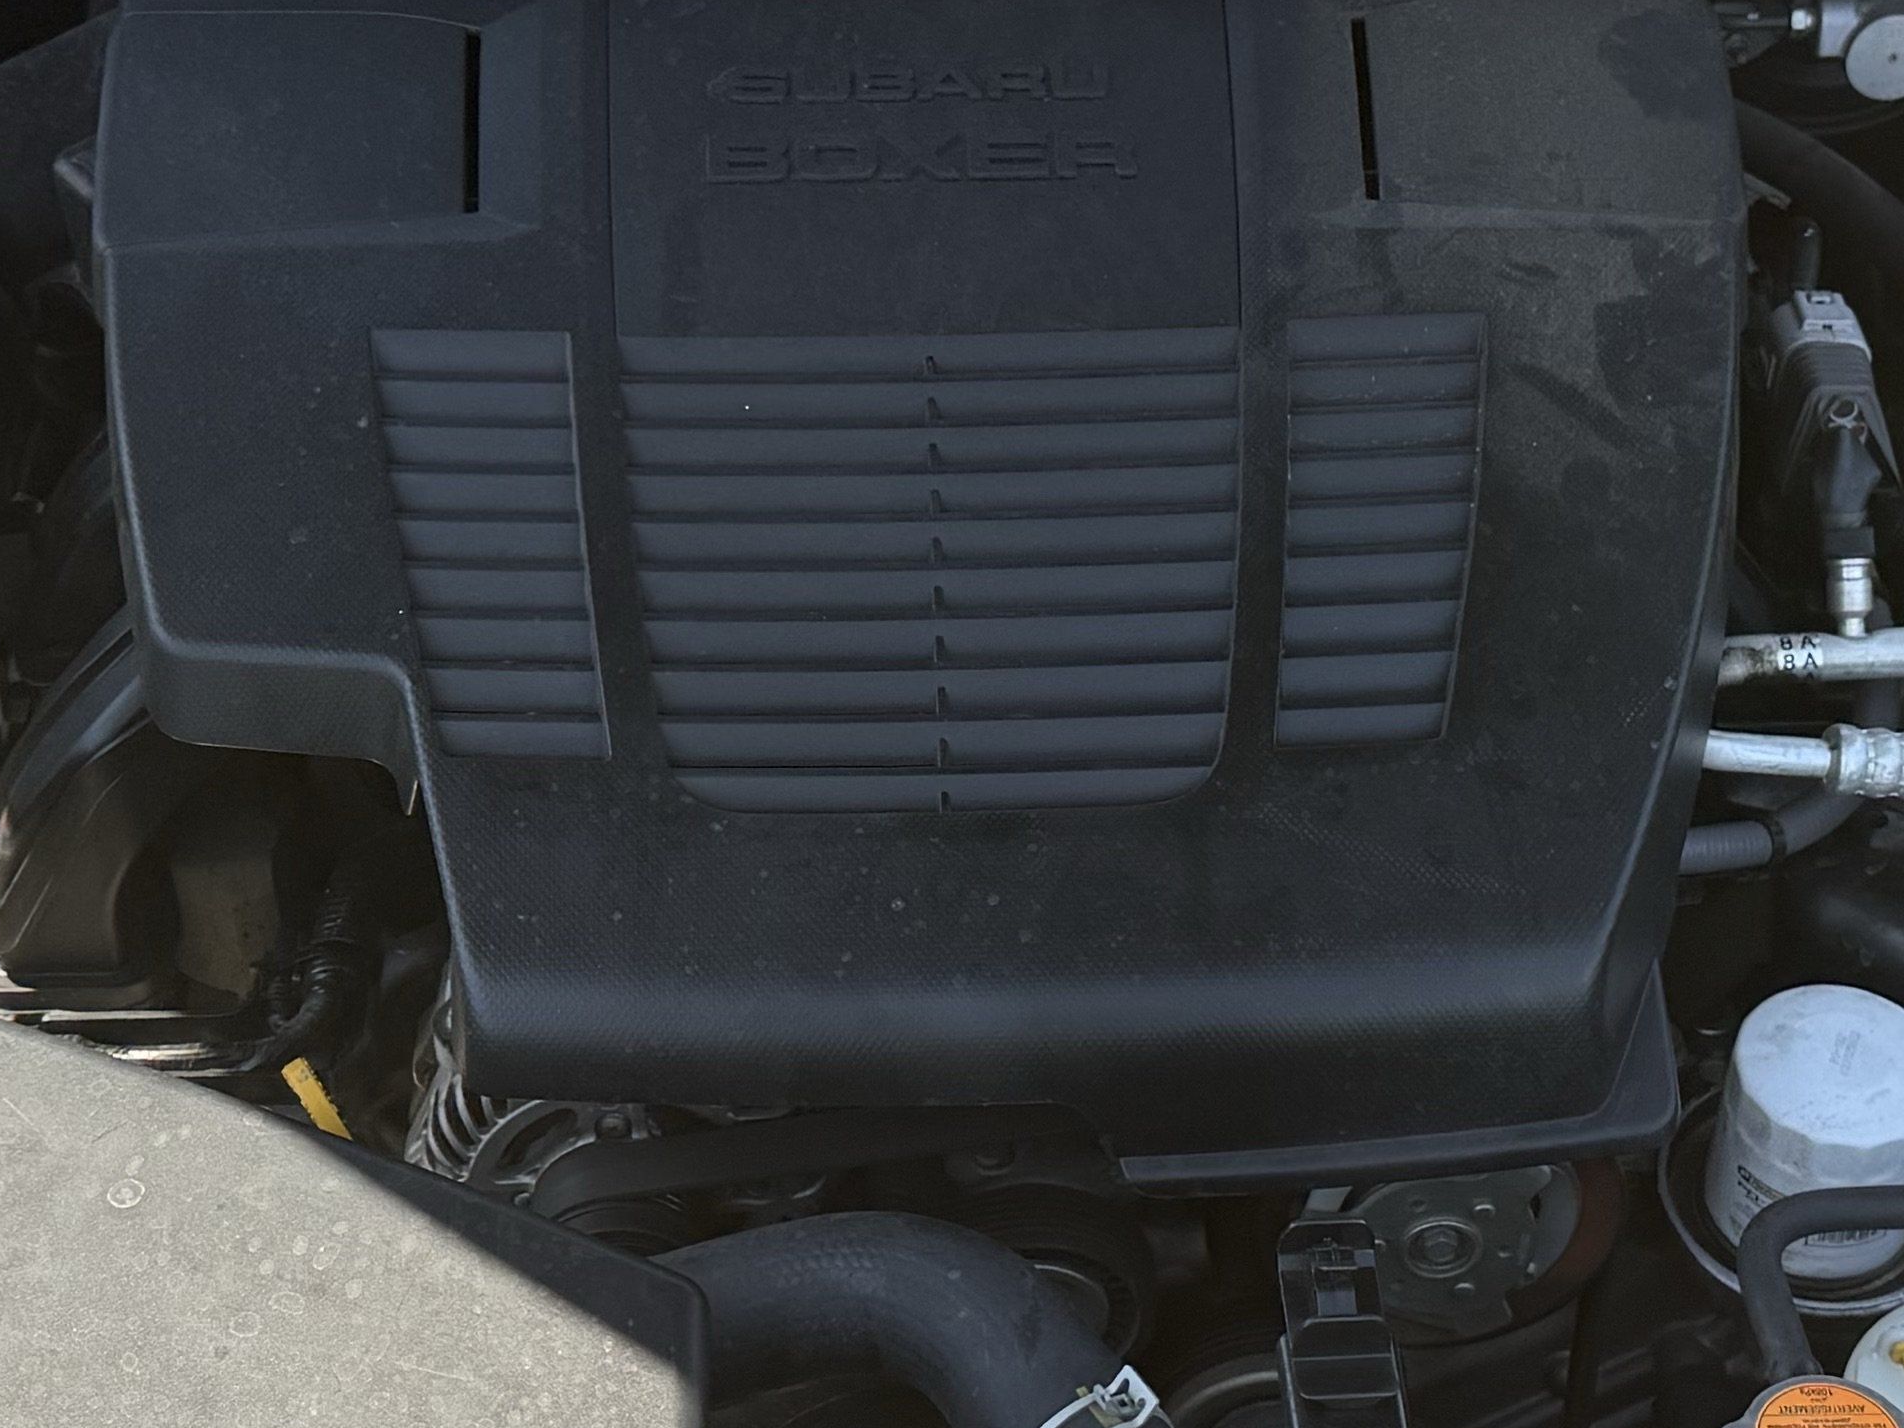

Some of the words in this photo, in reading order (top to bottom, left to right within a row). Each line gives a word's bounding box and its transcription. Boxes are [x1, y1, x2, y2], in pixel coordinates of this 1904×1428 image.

[710, 63, 1109, 105] SUBARU
[703, 131, 1140, 185] BOXER
[1783, 654, 1796, 671] 8
[1802, 652, 1819, 670] A
